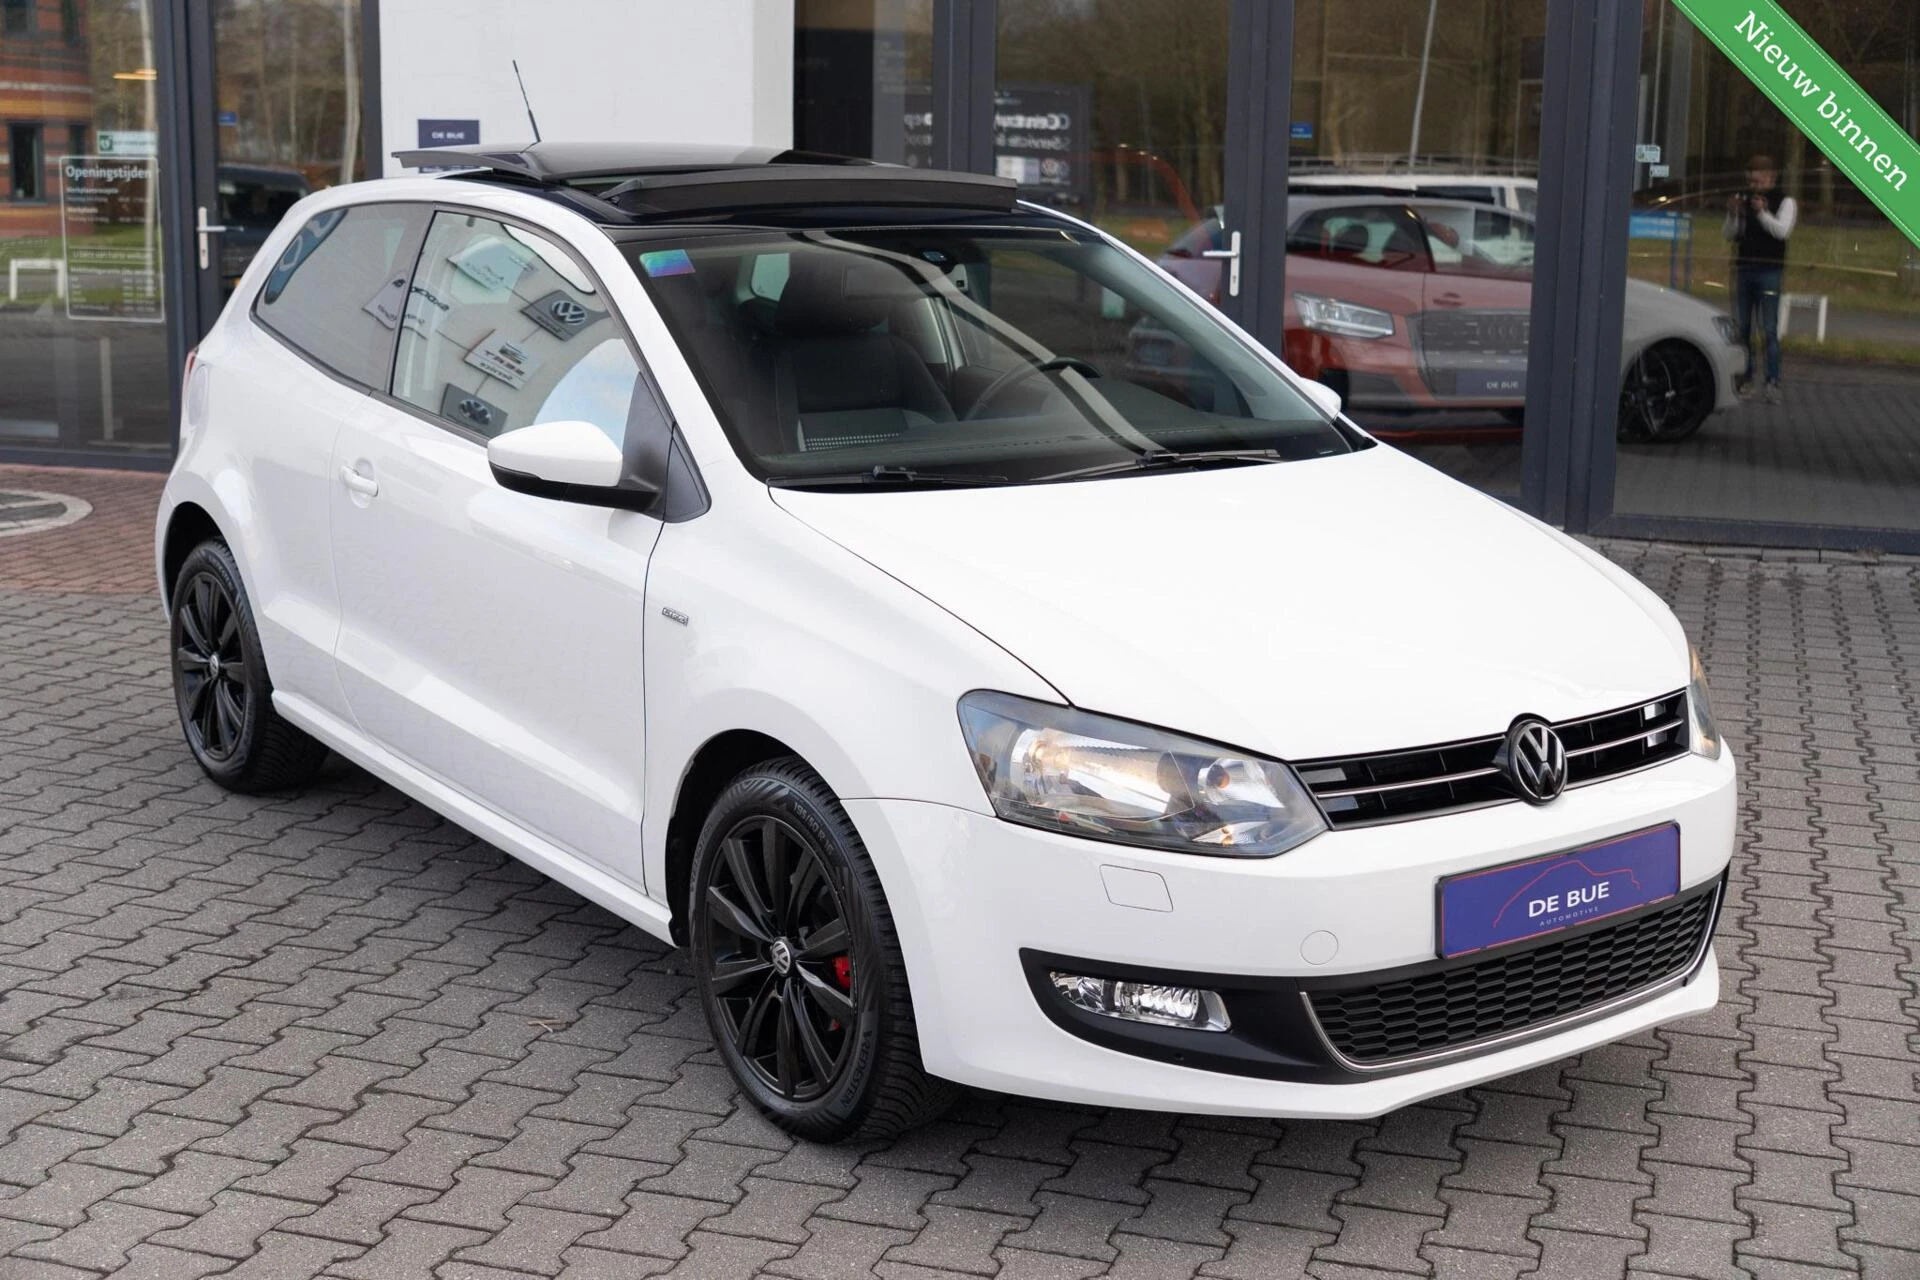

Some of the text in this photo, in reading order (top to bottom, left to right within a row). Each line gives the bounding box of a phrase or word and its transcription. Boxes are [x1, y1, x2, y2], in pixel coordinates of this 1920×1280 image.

[431, 131, 465, 139] DE BUE
[65, 165, 152, 182] Openingstijden
[1528, 881, 1610, 918] DE BUE
[1540, 906, 1599, 928] AUTOMOTIVE
